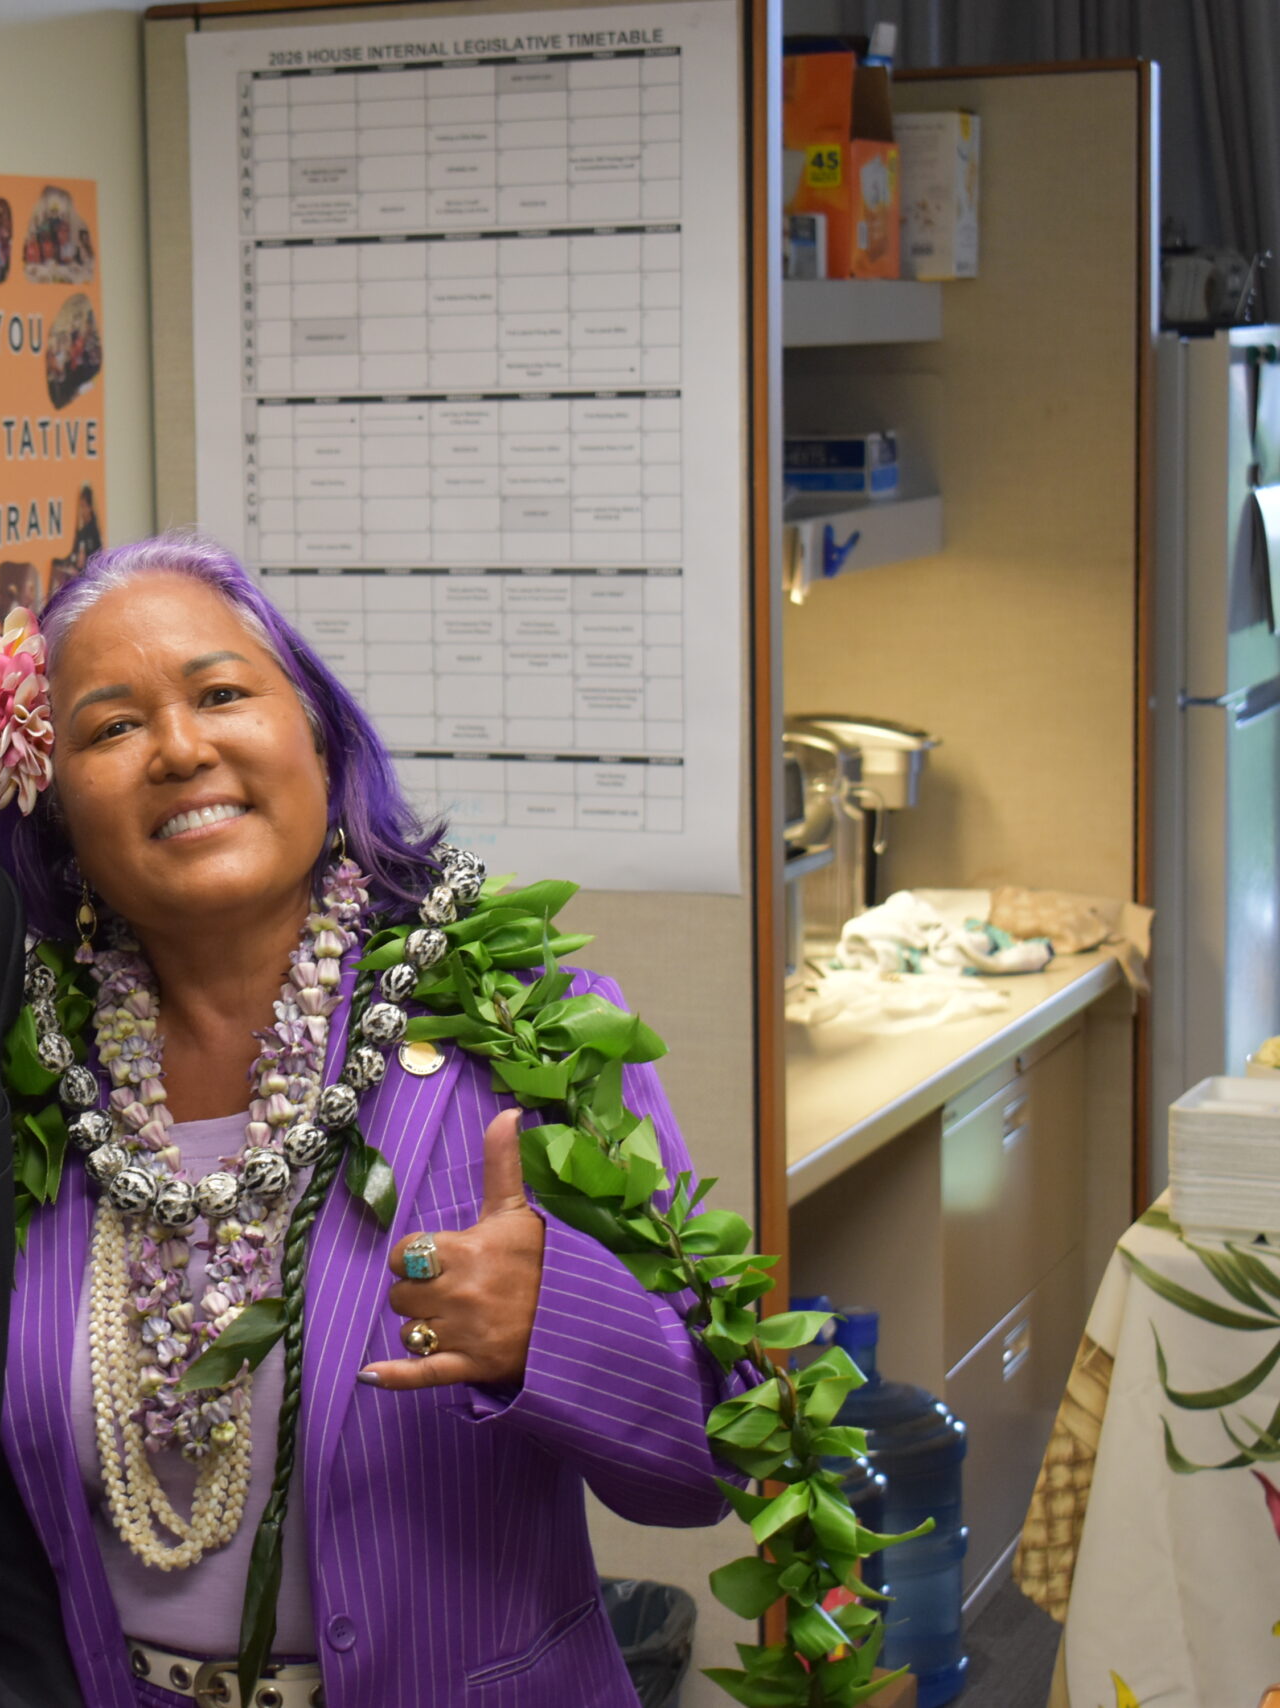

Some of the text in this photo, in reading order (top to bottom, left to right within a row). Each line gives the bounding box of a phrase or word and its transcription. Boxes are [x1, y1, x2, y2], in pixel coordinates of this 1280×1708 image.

[269, 29, 664, 67] 2026 HOUSE INTERNAL LEGISLATIVE TIMETABLE
[811, 152, 839, 170] 45
